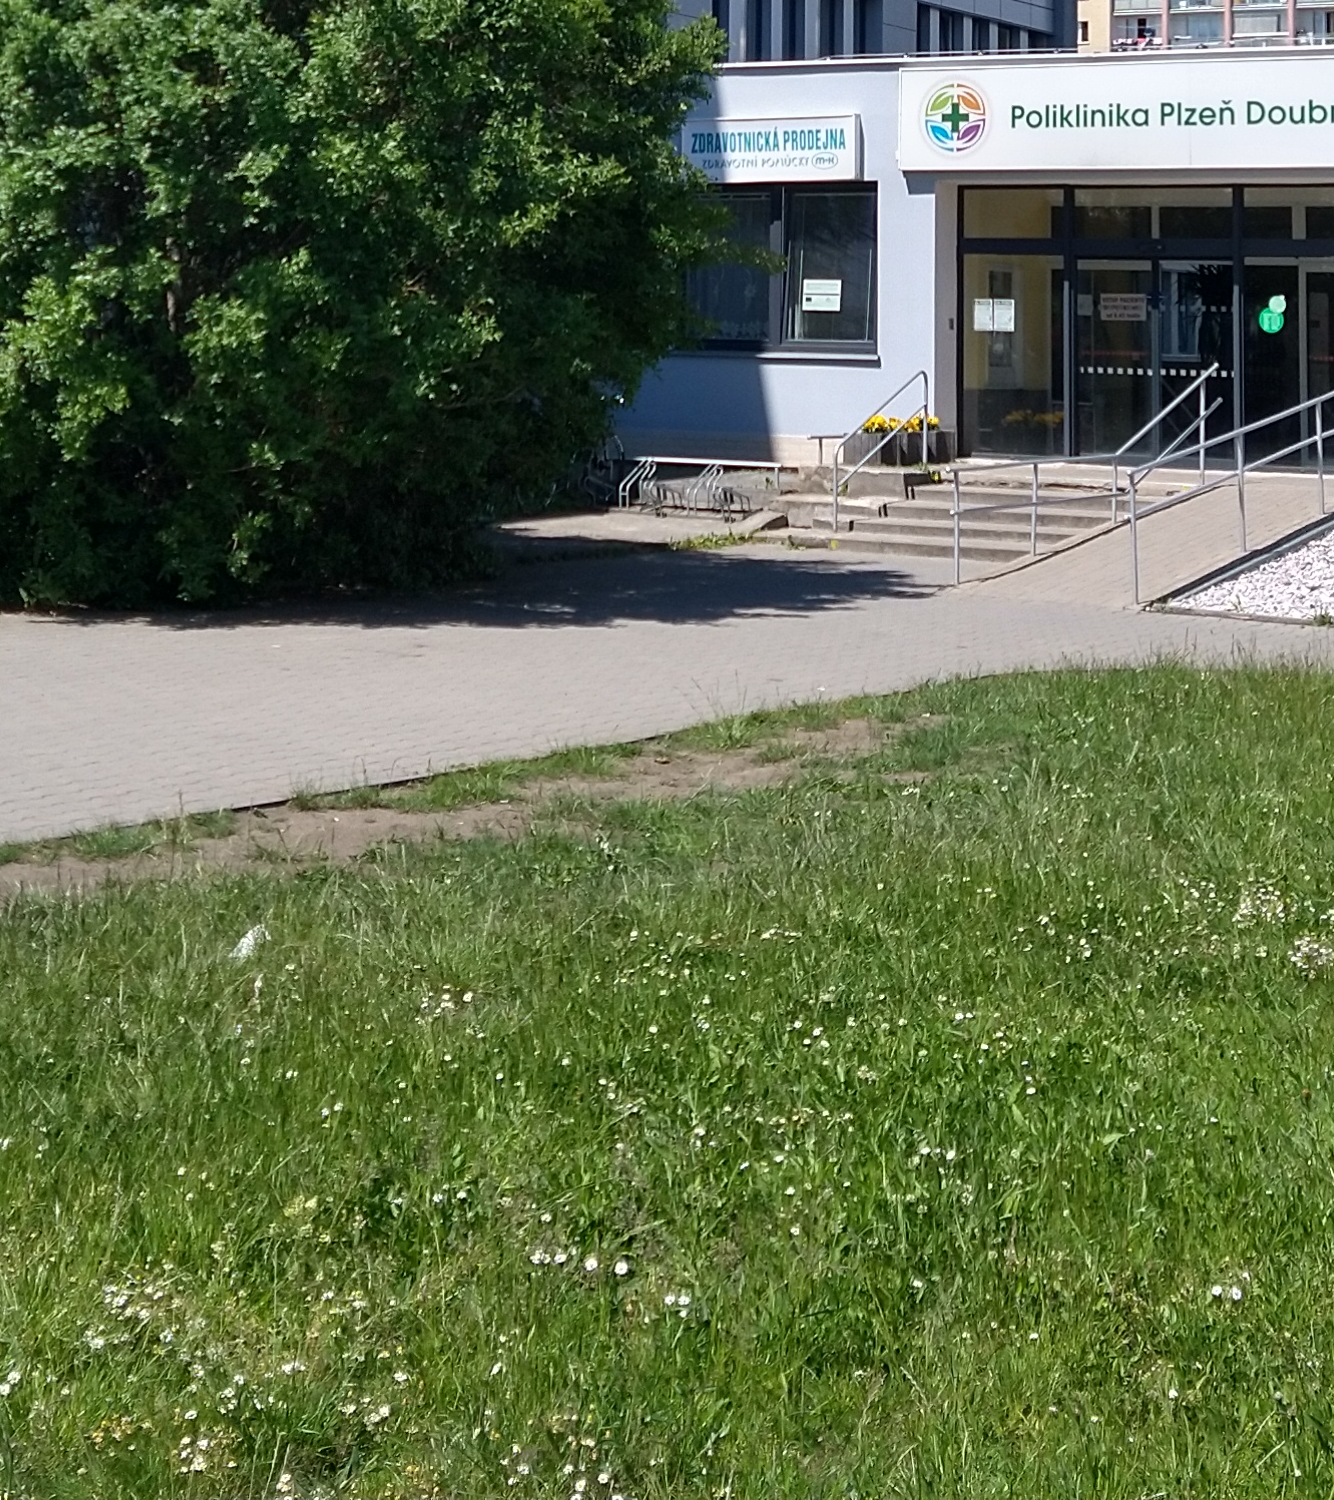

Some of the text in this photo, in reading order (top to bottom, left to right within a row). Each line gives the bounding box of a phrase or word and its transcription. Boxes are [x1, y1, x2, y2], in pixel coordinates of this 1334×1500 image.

[1010, 103, 1149, 129] Poliklinika
[1160, 99, 1235, 126] Plzeň
[691, 126, 847, 154] ZDRAVOTNICKÁ PRODEJNA
[702, 155, 758, 169] ZDRAVOTNÍ
